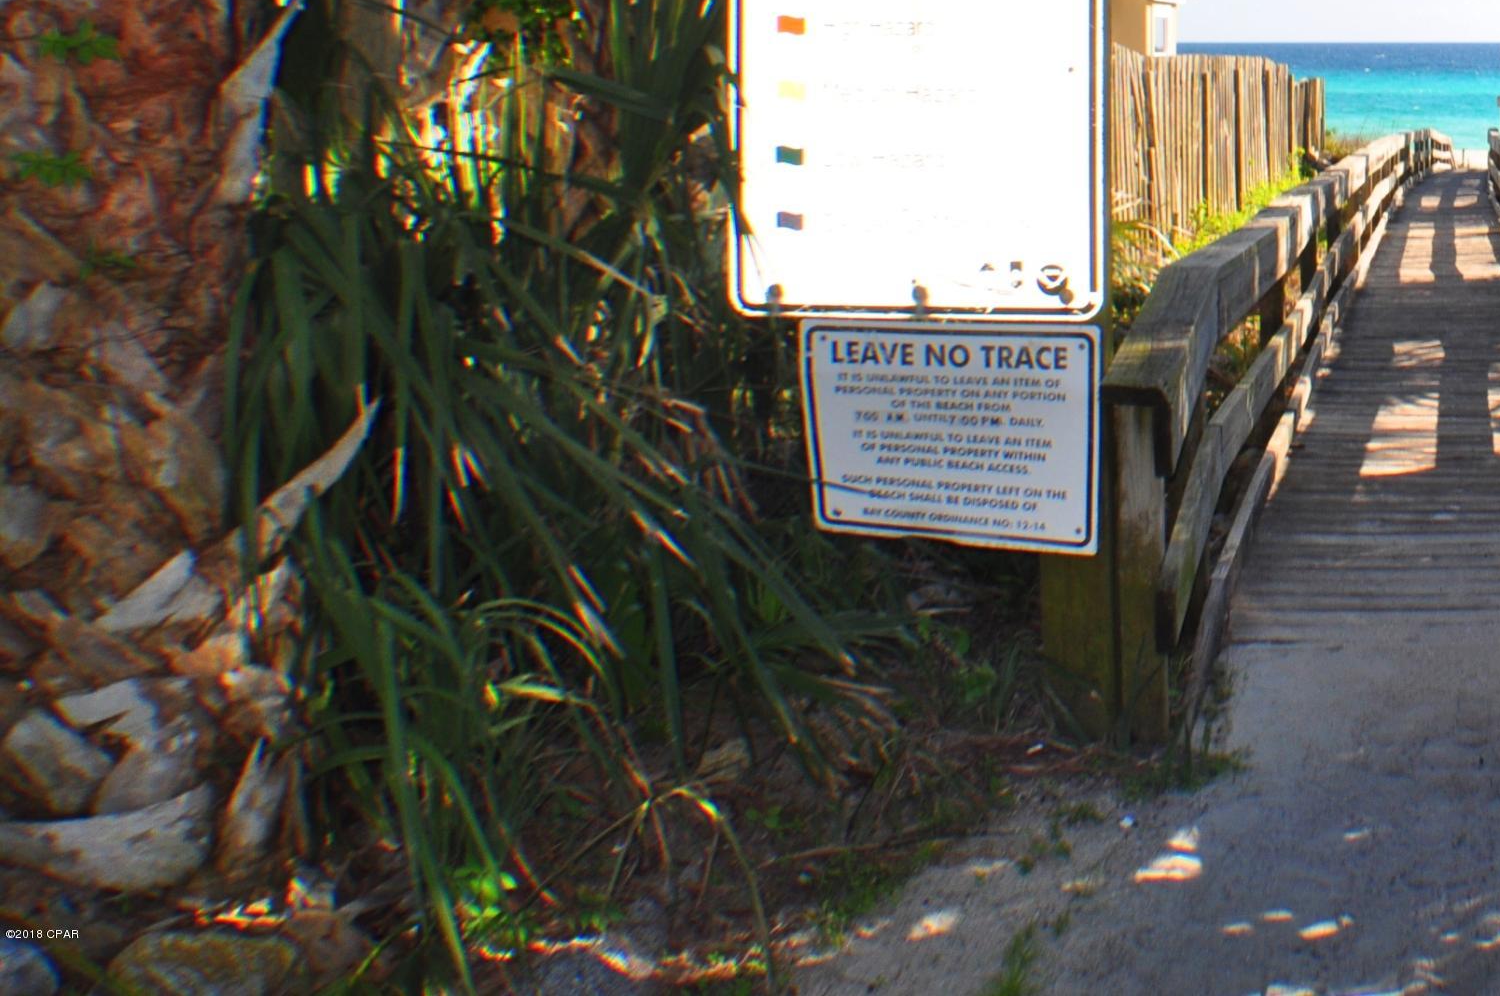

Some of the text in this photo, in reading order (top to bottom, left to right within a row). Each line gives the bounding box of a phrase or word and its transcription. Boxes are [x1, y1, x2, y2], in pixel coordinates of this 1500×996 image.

[831, 339, 1068, 371] LEAVE NO TRACE
[837, 372, 1061, 388] IT IS UNLAWFUL TO LEAVE AN ITEM OF
[833, 385, 1067, 402] PERSONAL PROPERTY ON ANY PORTION
[890, 399, 1012, 412] OF THE BEACH FROM
[852, 430, 1053, 448] IT IS UNLAWFUL TO LEAVE AN ITEM
[861, 442, 1047, 462] OF PERSONAL PROPERTY WITHIN
[876, 456, 901, 465] ANY
[903, 457, 944, 468] PUBLIC
[946, 460, 985, 471] BEACH
[841, 474, 1068, 500] SUCH PERSONAL PROPERTY LEFT ON THE
[909, 491, 944, 503] SHALL
[946, 494, 960, 505] BE
[962, 496, 1020, 510] DISPOSED
[1022, 501, 1038, 512] OF
